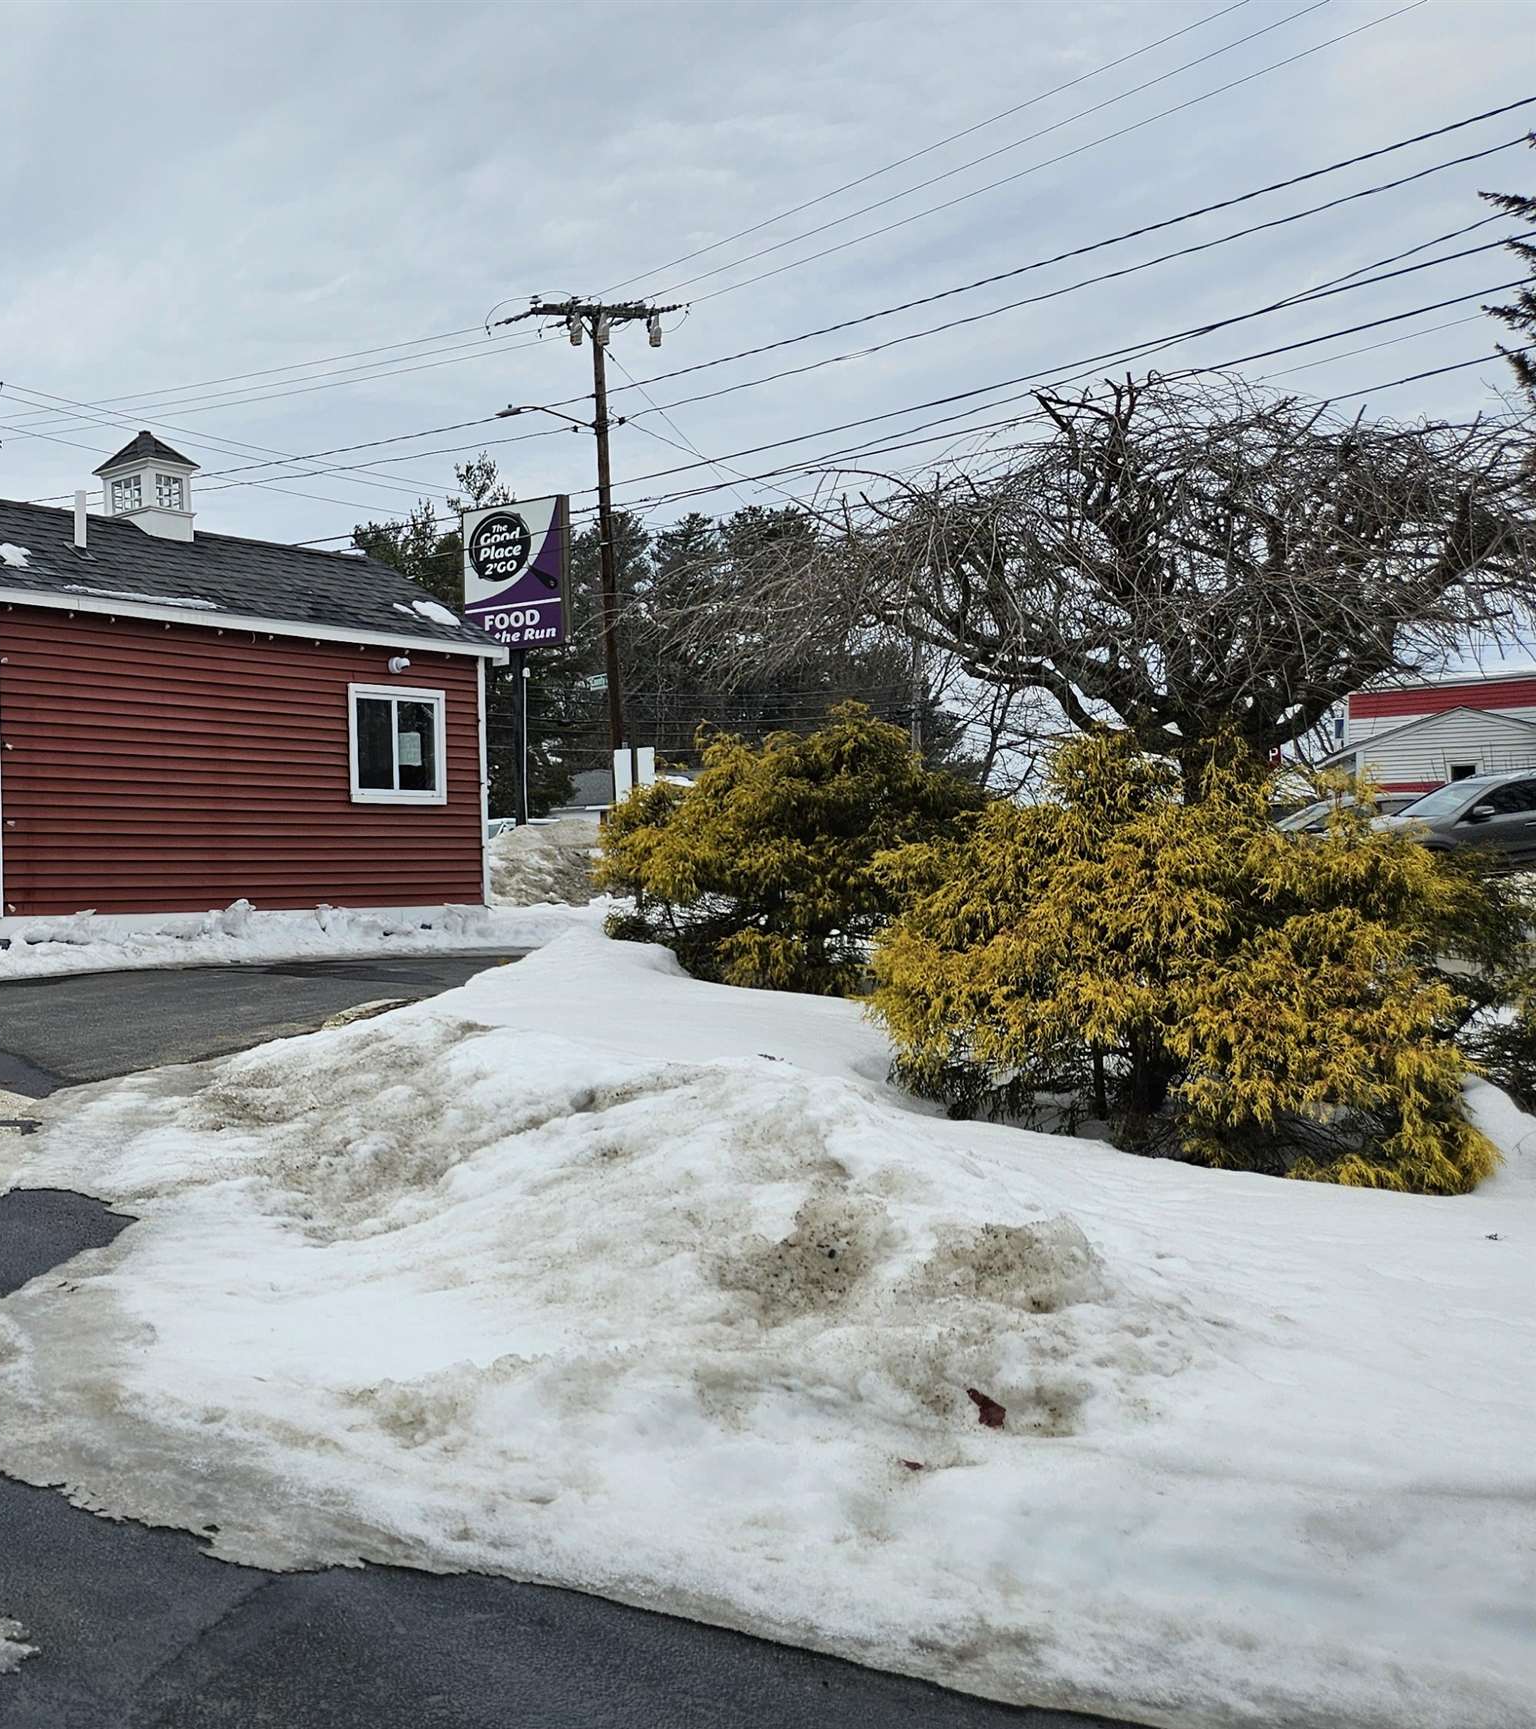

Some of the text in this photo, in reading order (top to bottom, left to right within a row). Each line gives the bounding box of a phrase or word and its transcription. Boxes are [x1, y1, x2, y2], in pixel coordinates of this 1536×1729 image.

[480, 526, 521, 546] Good
[492, 523, 508, 533] The
[479, 544, 522, 562] Place
[484, 609, 540, 631] FOOD
[524, 627, 557, 641] Run
